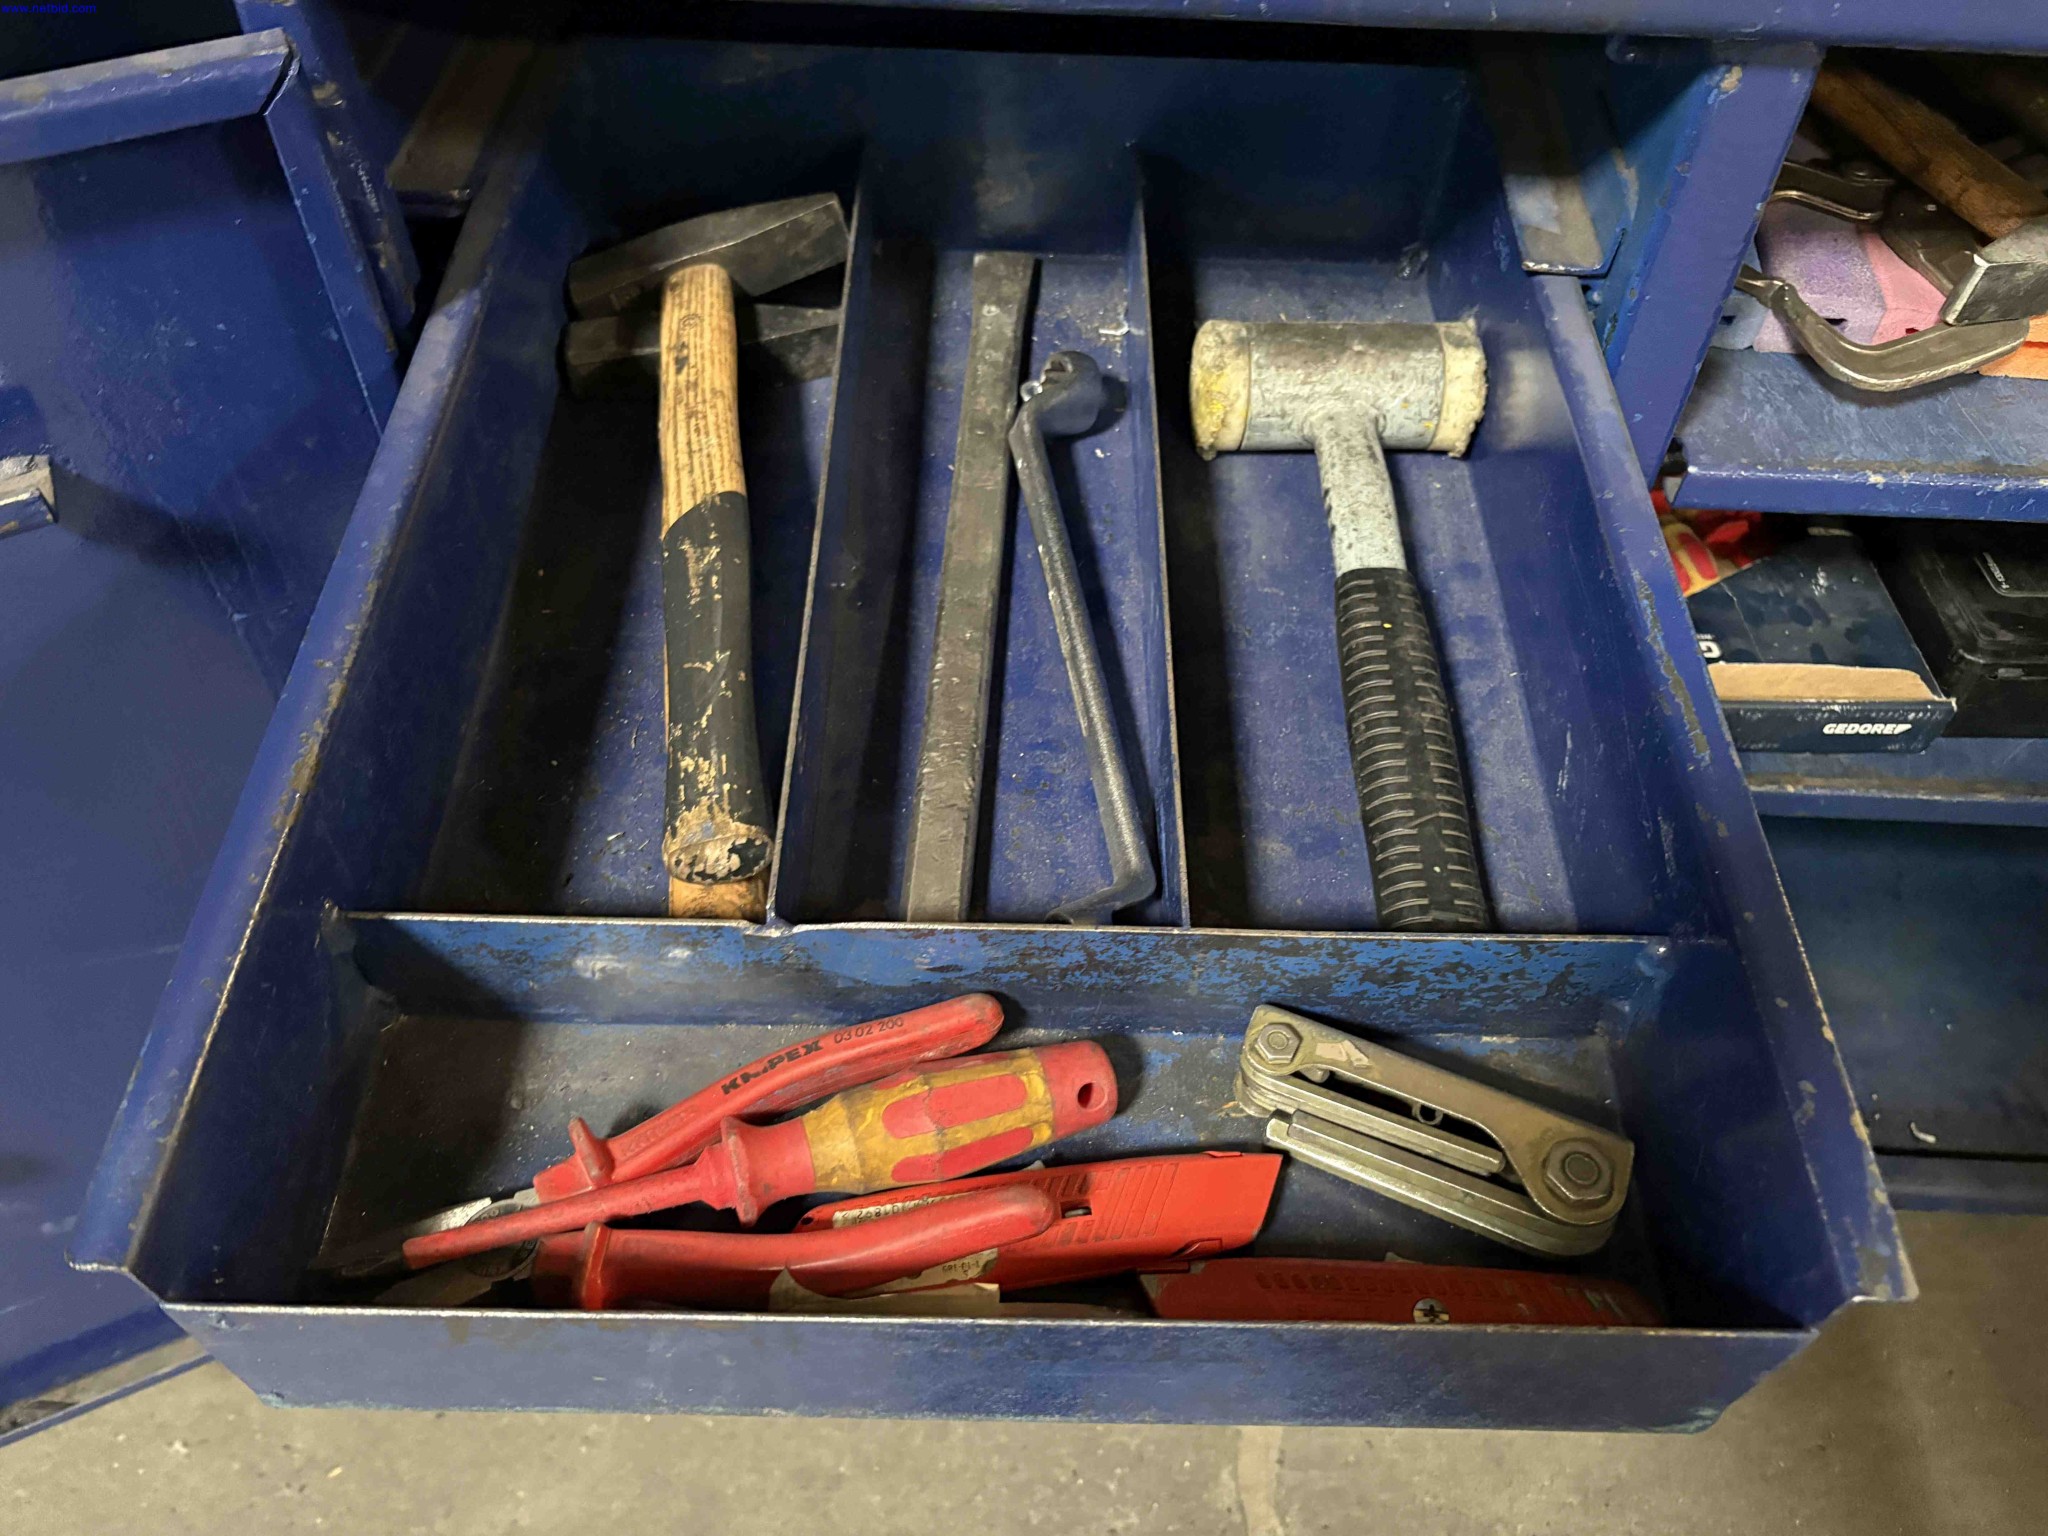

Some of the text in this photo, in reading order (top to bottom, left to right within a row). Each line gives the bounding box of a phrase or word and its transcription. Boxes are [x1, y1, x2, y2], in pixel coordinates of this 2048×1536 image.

[1822, 723, 1898, 735] GEDORE
[834, 1030, 852, 1044] 03
[855, 1024, 873, 1038] 02
[878, 1017, 905, 1032] 200
